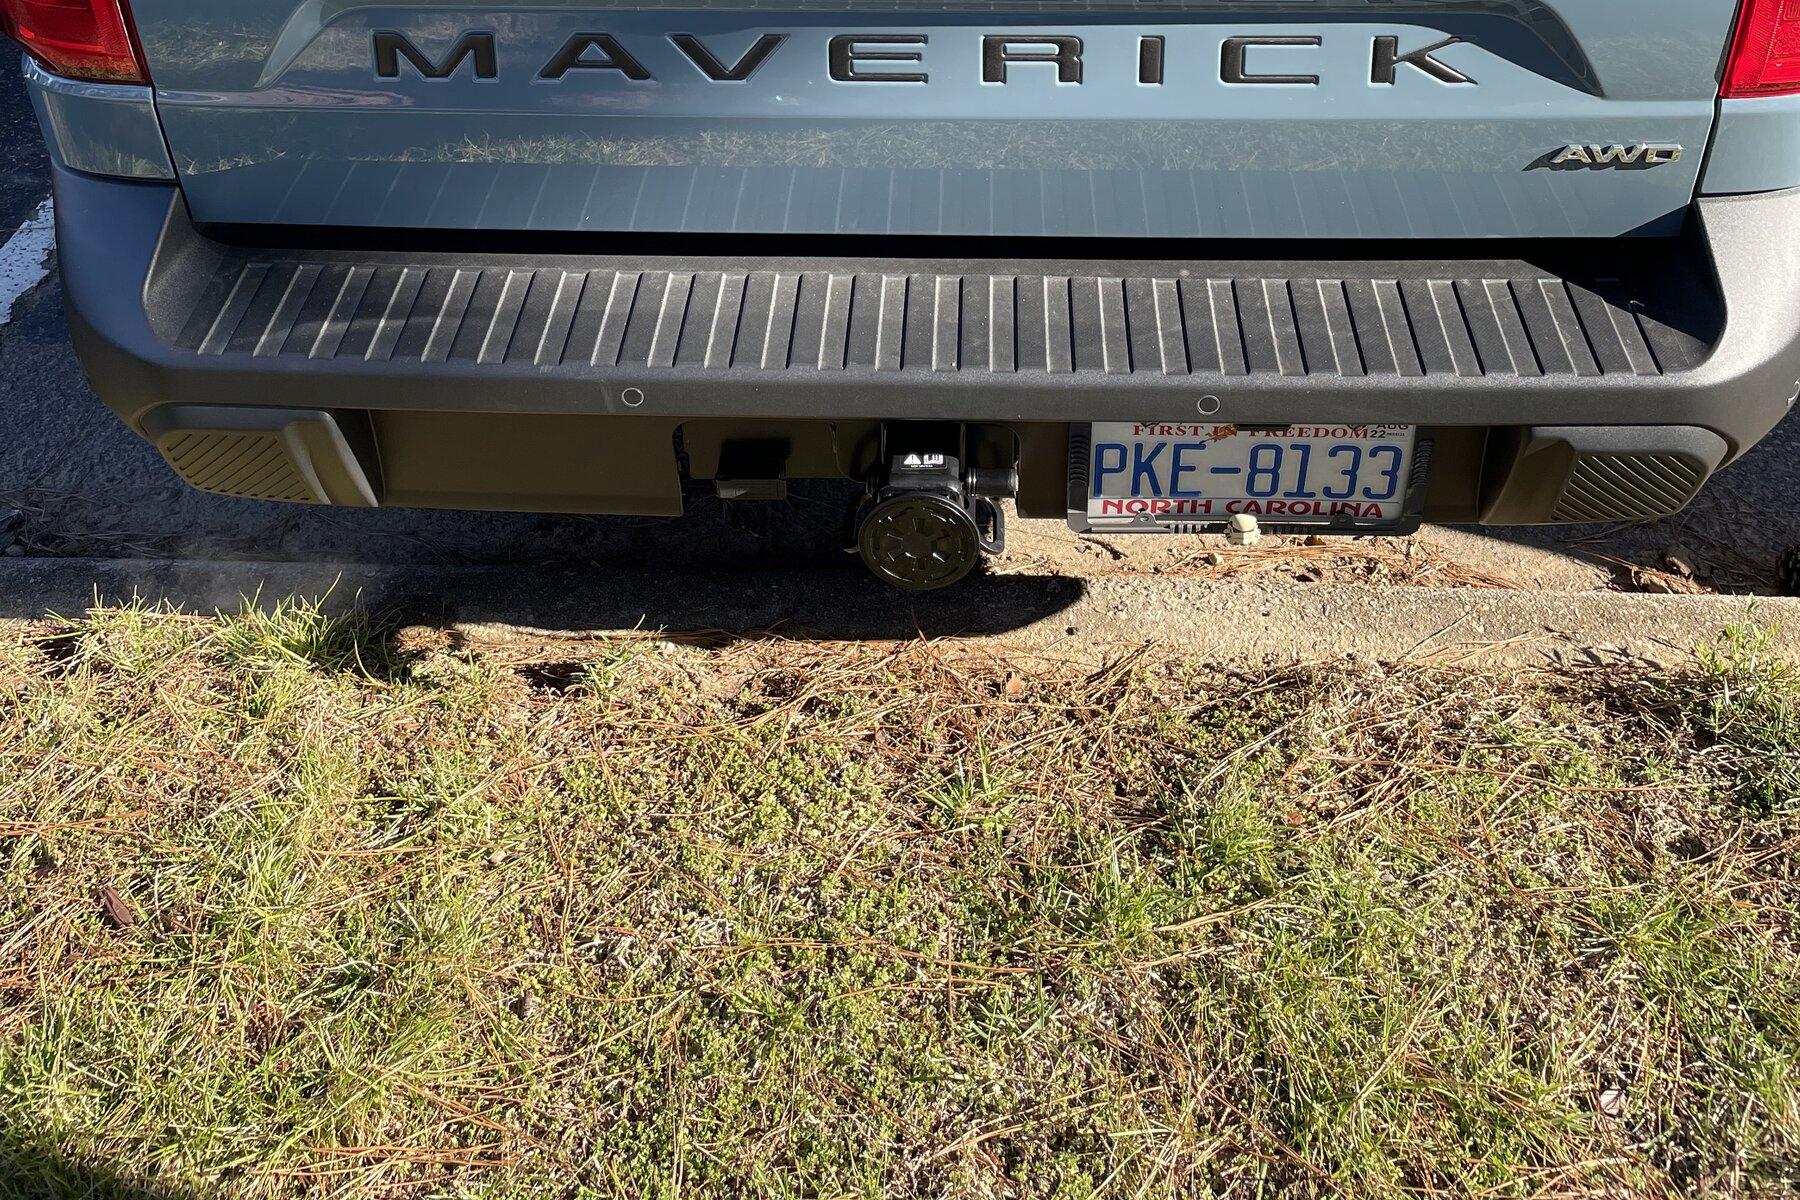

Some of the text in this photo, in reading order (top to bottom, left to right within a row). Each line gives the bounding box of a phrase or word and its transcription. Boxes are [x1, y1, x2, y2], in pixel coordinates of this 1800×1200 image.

[373, 30, 1477, 86] MAVERICK
[1551, 143, 1683, 163] AWD
[1133, 424, 1204, 437] FIRST
[1249, 426, 1368, 439] FREEDOM
[1369, 430, 1386, 438] 22
[1093, 442, 1402, 499] PKE-8133
[1102, 499, 1383, 518] NORTH CAROLINA
